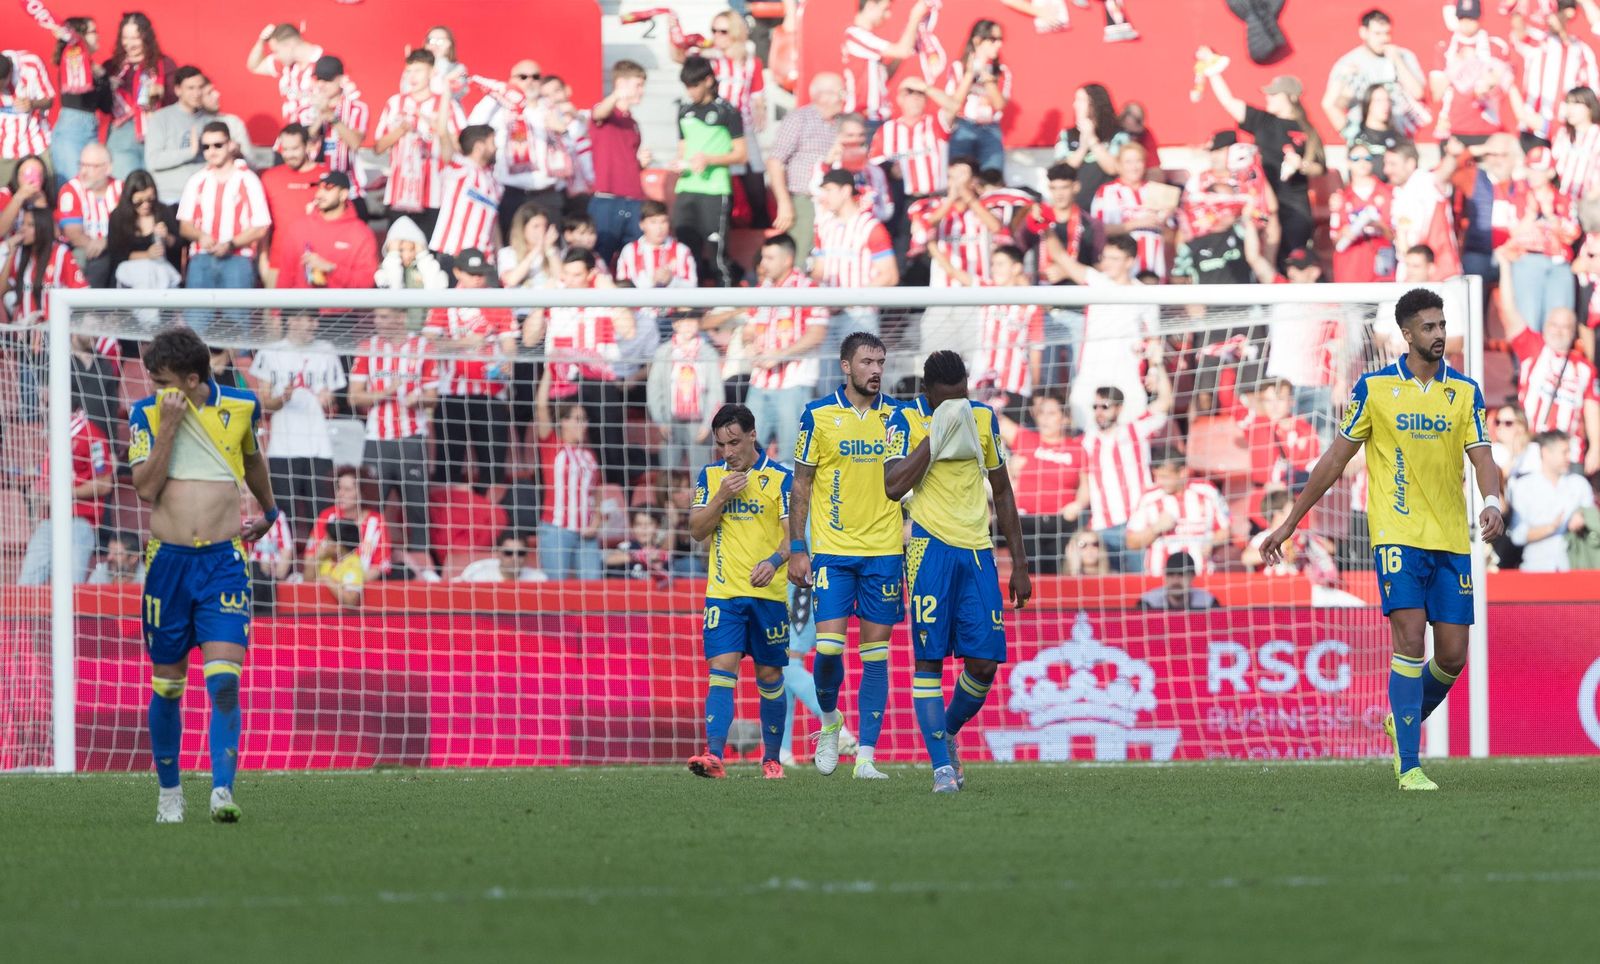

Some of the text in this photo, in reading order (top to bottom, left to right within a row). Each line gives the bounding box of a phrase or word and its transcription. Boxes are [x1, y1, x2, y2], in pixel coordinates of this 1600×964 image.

[642, 20, 656, 39] 2
[1410, 432, 1439, 440] Telecom
[1378, 546, 1402, 575] 16
[144, 594, 161, 629] 11
[913, 595, 937, 623] 12
[1208, 639, 1350, 693] RSG
[1207, 705, 1352, 731] BUSINESS
